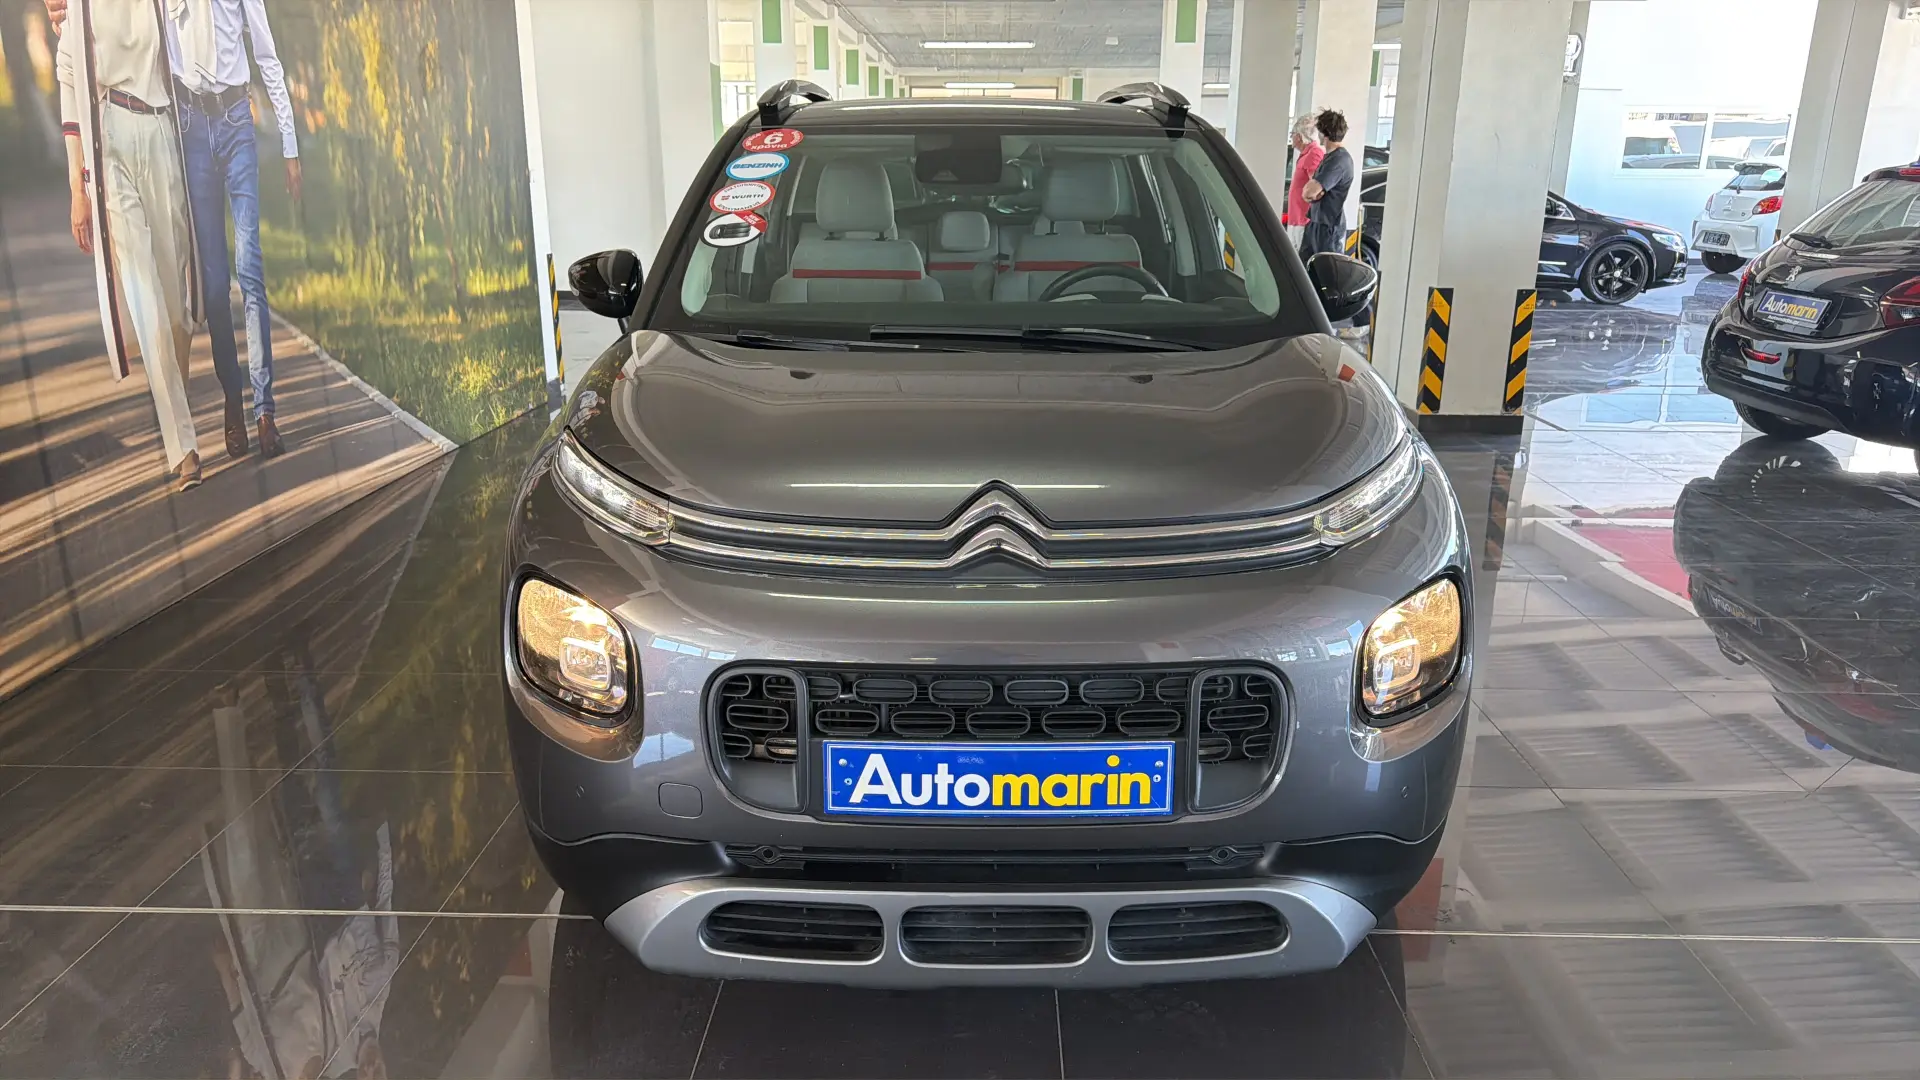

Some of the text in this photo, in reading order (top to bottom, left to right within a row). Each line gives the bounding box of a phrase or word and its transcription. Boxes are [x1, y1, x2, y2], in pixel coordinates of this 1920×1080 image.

[763, 133, 784, 145] 6
[1762, 295, 1818, 319] Automarin
[849, 753, 1151, 806] Automarin
